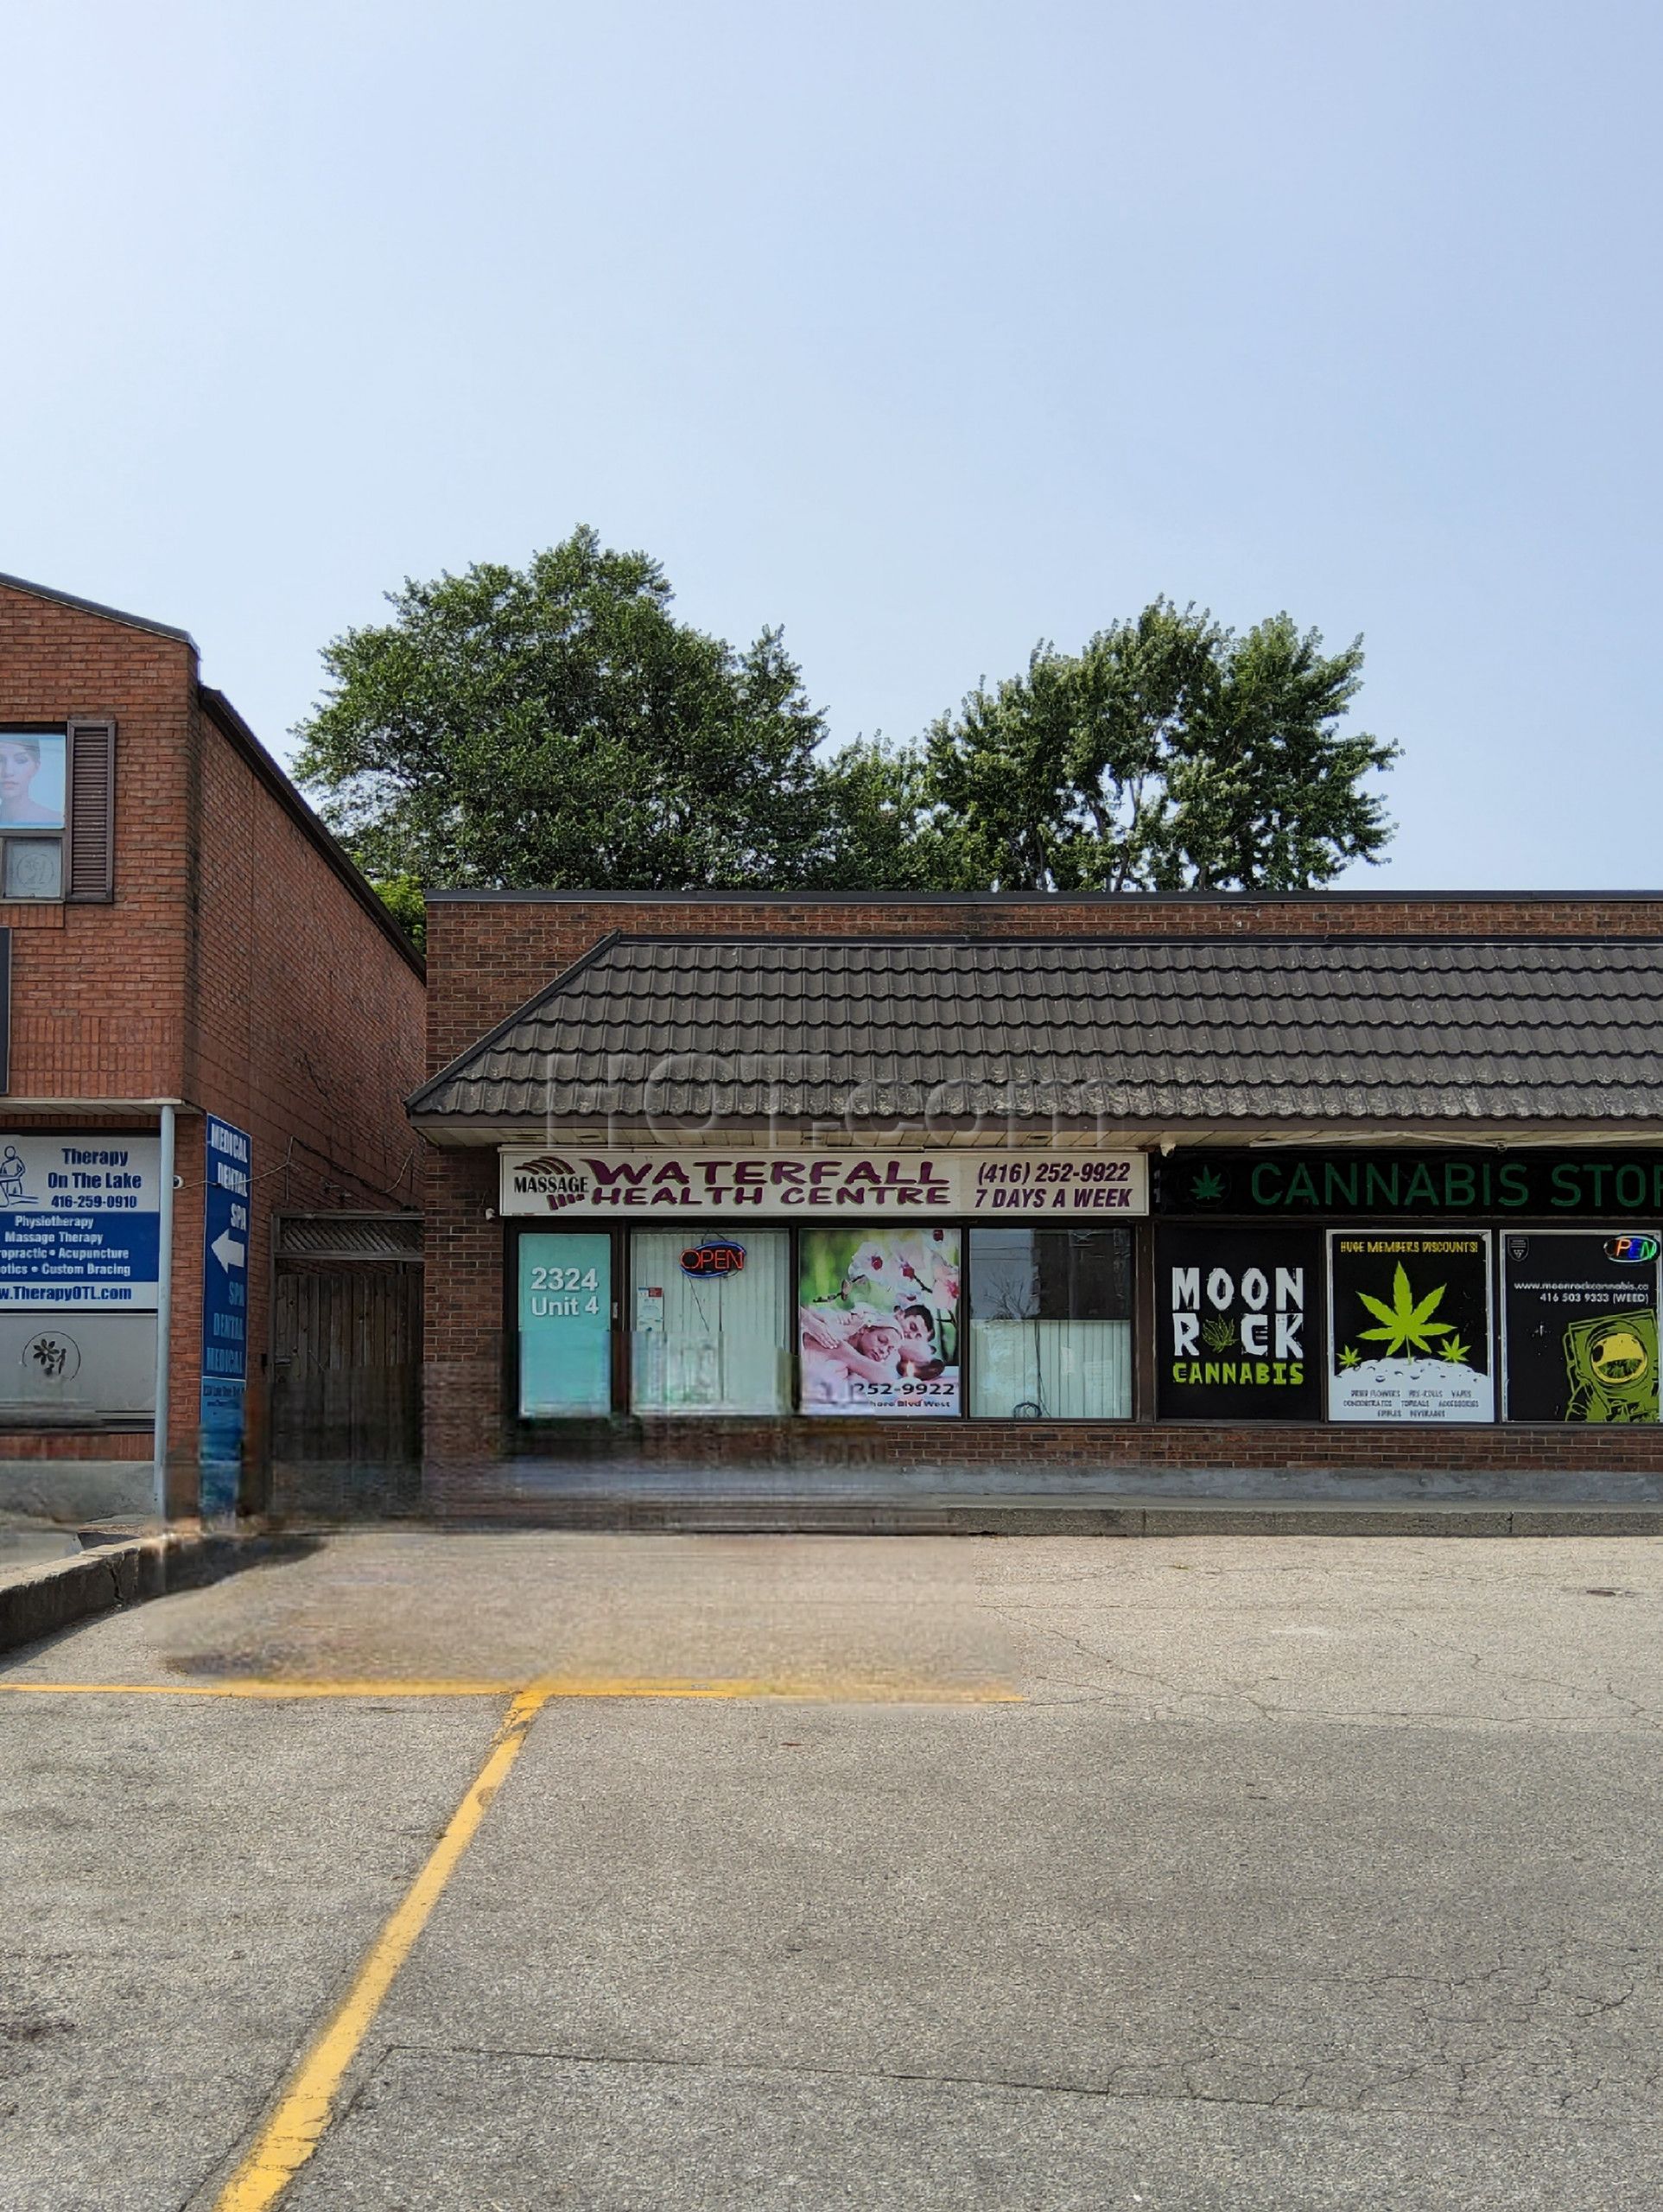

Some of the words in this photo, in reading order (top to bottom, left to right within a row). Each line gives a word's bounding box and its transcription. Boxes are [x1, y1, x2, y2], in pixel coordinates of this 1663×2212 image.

[211, 1123, 248, 1163] MEDICAL
[61, 1147, 128, 1166] Therapy
[48, 1173, 67, 1188] On
[73, 1173, 102, 1188] The
[105, 1173, 142, 1188] Lake
[580, 1158, 949, 1185] WATERFALL
[978, 1162, 1031, 1185] (416)
[1034, 1162, 1131, 1184] 252-9922
[514, 1176, 588, 1193] MASSAGE
[1252, 1162, 1529, 1206] CANNABIS
[51, 1195, 137, 1208] 416-259-0910
[591, 1187, 764, 1206] HEALTH
[779, 1187, 950, 1206] CENTRE
[974, 1189, 987, 1208] 7
[993, 1189, 1045, 1208] DAYS
[1051, 1189, 1066, 1207] A
[1073, 1189, 1133, 1208] WEEK
[15, 1215, 94, 1229] Physiotherapy
[4, 1231, 55, 1244] Massage
[58, 1231, 104, 1245] Therapy
[1341, 1242, 1364, 1252] HUGE
[58, 1248, 129, 1261] Acupuncture
[1605, 1238, 1656, 1259] PEN
[41, 1262, 84, 1274] Custom
[87, 1262, 130, 1276] Bracing
[680, 1249, 745, 1270] OPEN
[530, 1268, 599, 1291] 2324
[1172, 1267, 1303, 1311] MOON
[532, 1298, 579, 1315] Unit
[584, 1298, 600, 1314] 4
[1539, 1293, 1558, 1302] 416
[1562, 1293, 1581, 1302] 503
[1584, 1293, 1609, 1302] 9333
[1613, 1293, 1649, 1305] (WEED)
[213, 1313, 244, 1340] DENTAL
[1172, 1313, 1304, 1358] RCK
[206, 1347, 243, 1374] MEDICAL
[1173, 1362, 1304, 1385] CANNABIS
